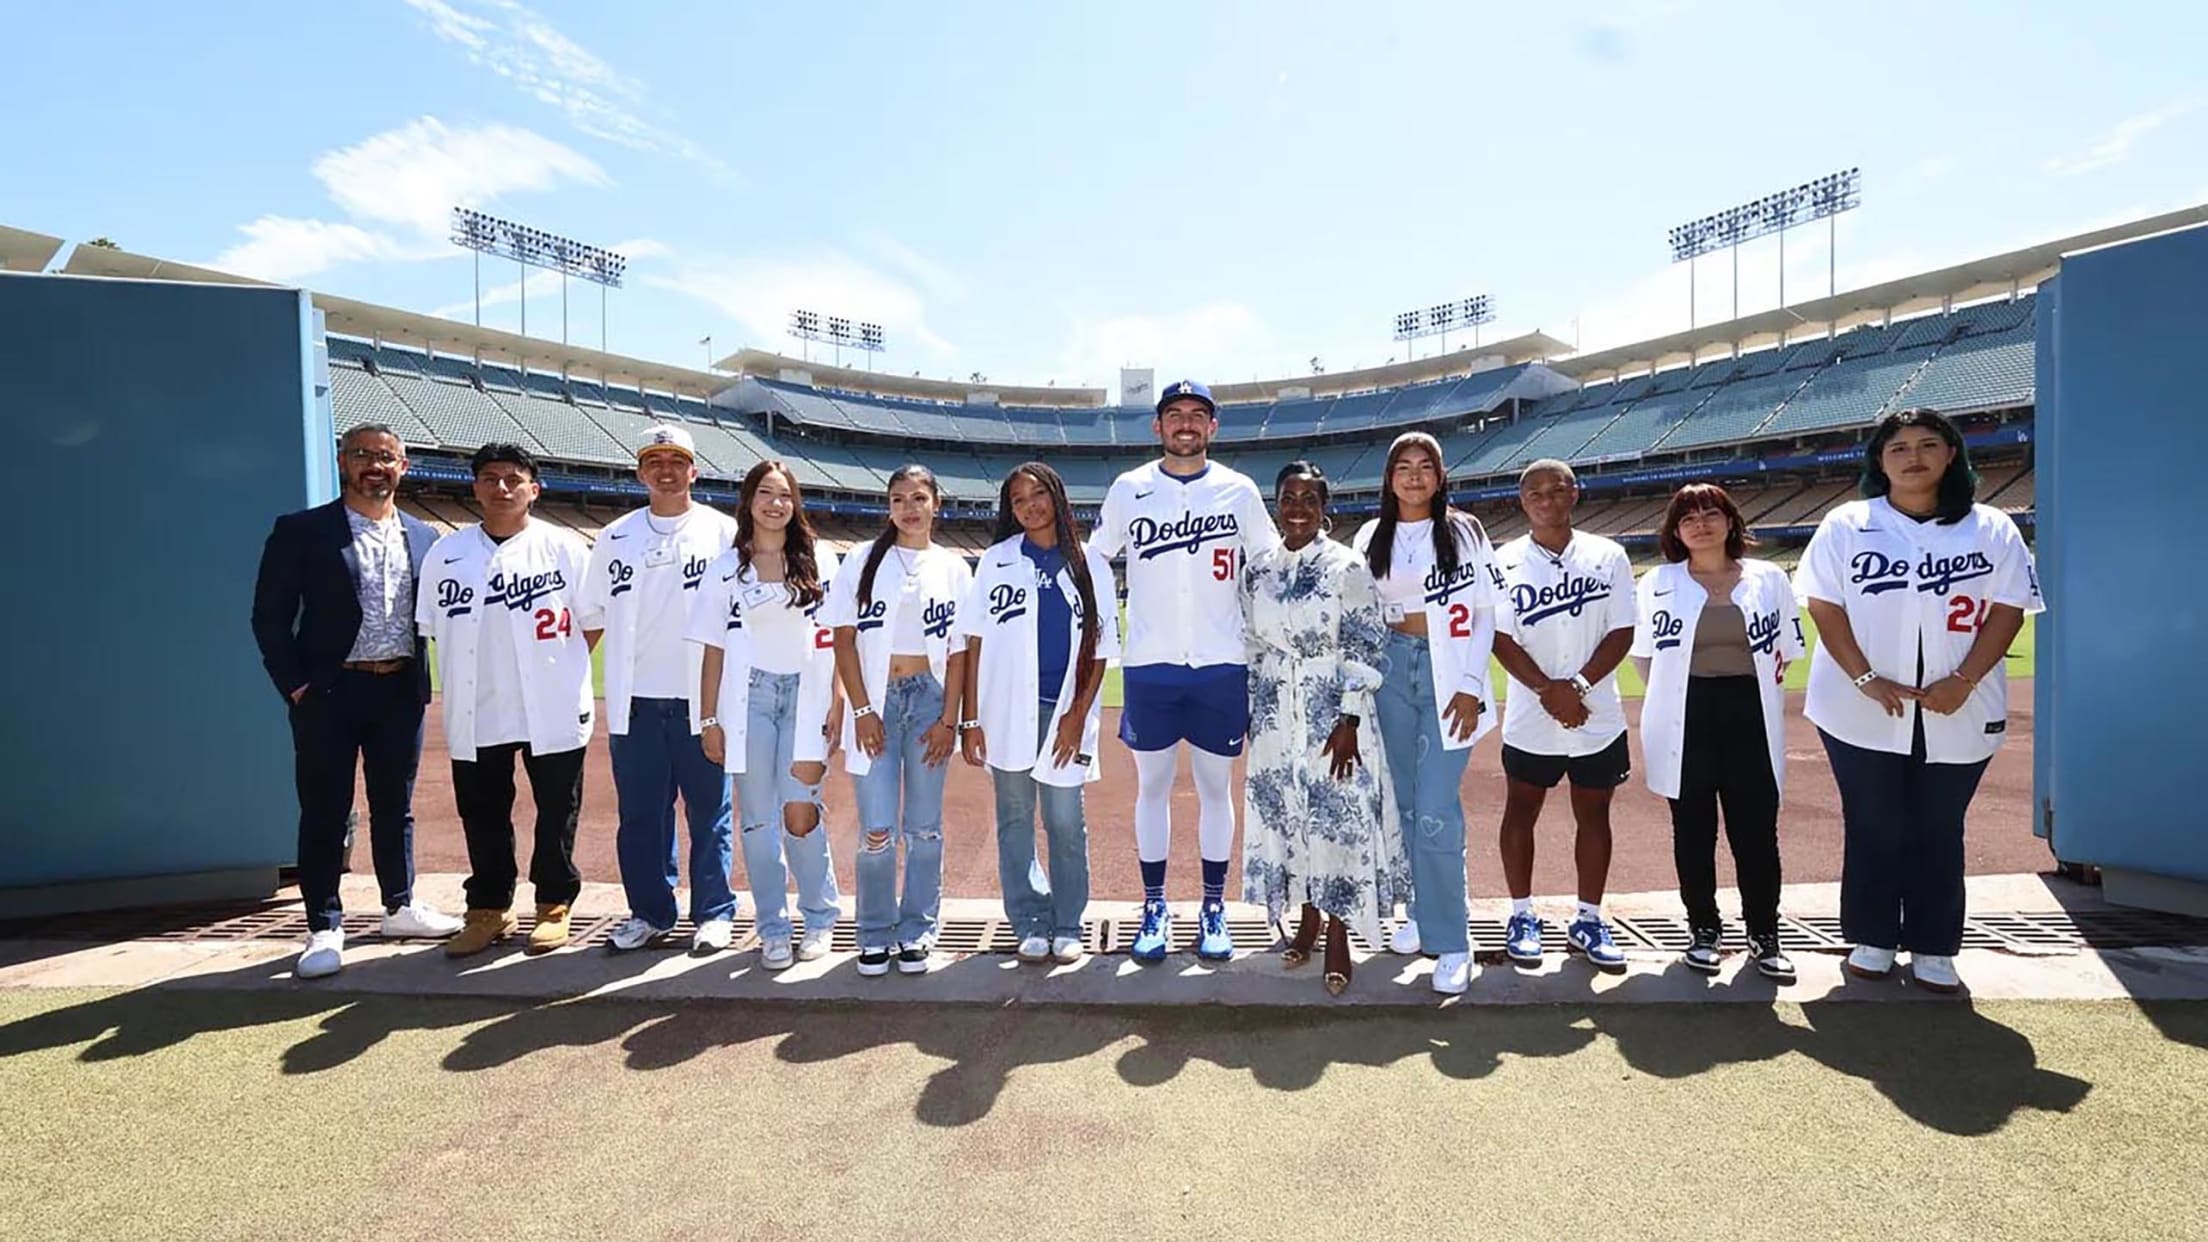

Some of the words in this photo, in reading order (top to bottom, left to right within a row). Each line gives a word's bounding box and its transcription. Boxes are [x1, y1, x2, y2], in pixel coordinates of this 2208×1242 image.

[1129, 510, 1239, 560] Dodgers
[1213, 547, 1234, 581] 51
[534, 607, 571, 640] 24
